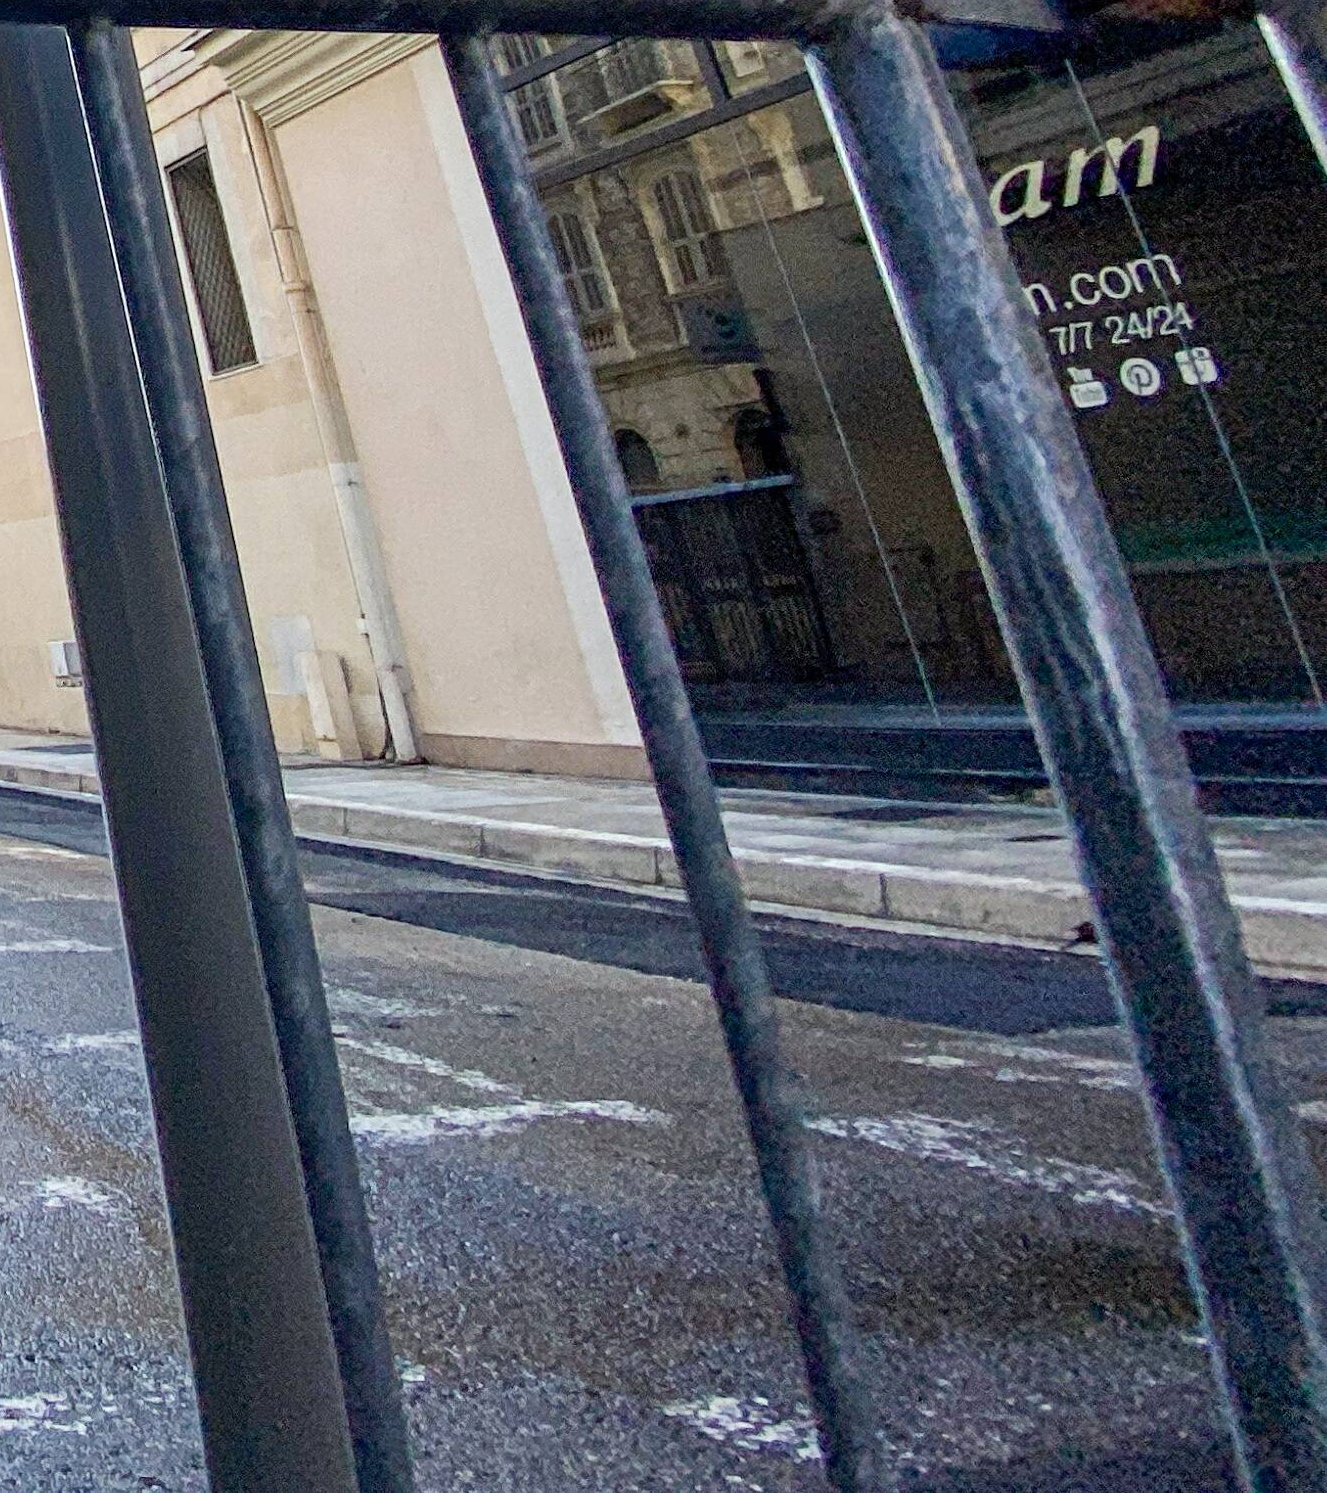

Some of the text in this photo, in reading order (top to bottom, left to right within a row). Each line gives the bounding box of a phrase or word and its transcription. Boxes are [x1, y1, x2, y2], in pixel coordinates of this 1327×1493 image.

[990, 124, 1160, 228] am
[1022, 254, 1182, 316] n.com
[1105, 302, 1193, 344] 24/24
